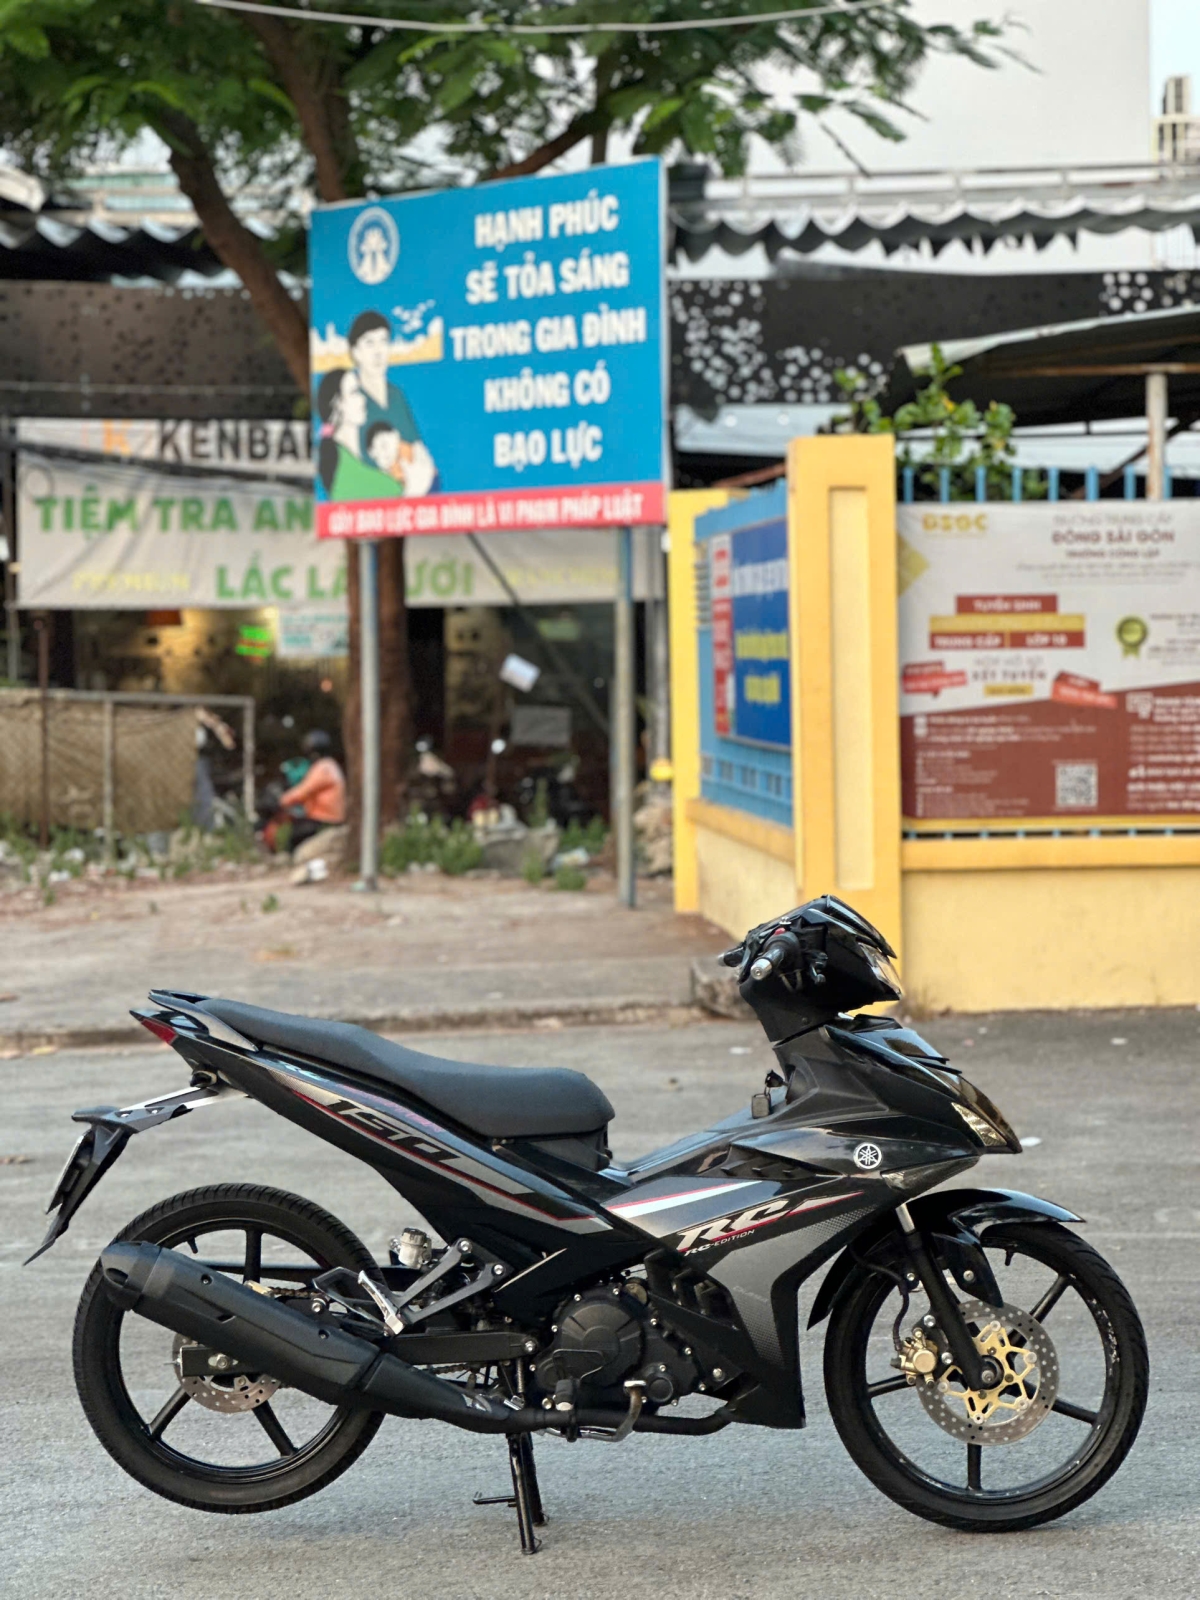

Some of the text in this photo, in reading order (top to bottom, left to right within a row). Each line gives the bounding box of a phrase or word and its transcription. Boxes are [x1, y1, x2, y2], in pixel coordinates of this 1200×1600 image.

[475, 189, 619, 252] HẠNH PHÚC
[465, 248, 630, 304] SẼ TỎA SÁNG
[450, 302, 647, 361] TRONG GIA ĐÌNH
[484, 360, 611, 413] KHÔNG CÓ
[159, 418, 313, 461] KENBA
[494, 421, 603, 472] BẠO LỰC
